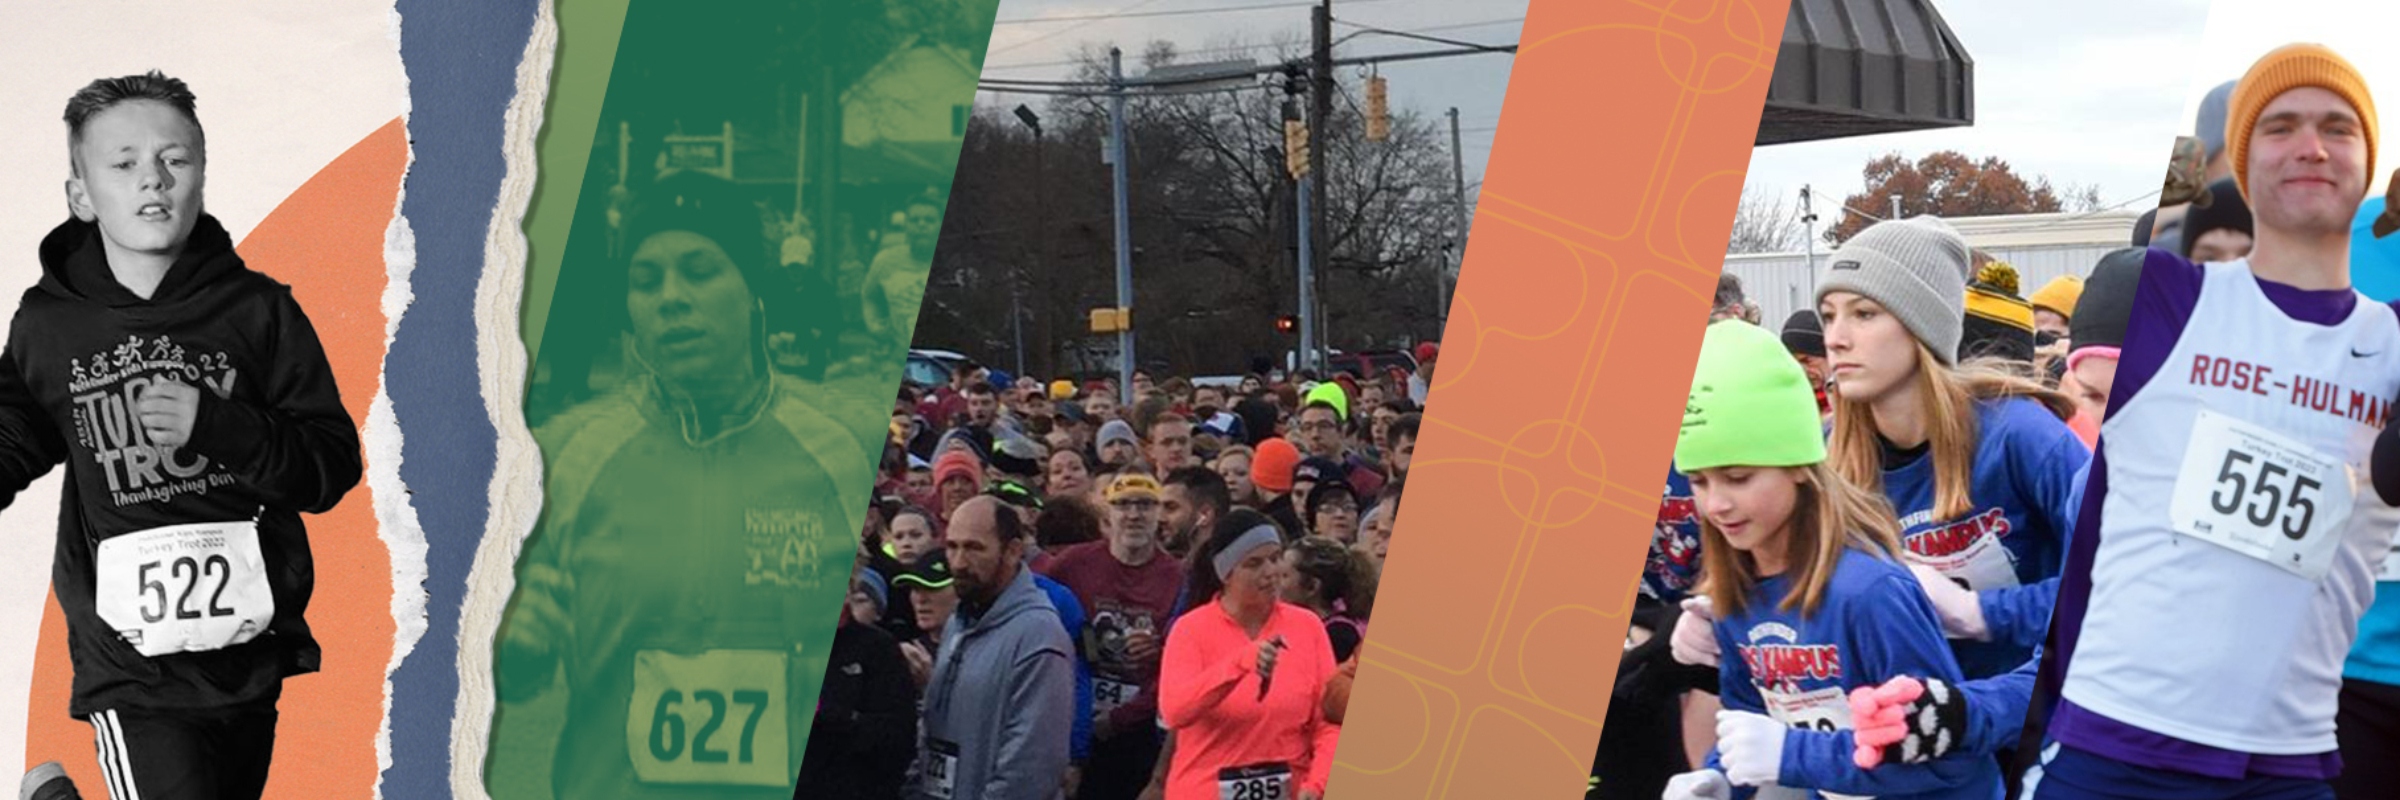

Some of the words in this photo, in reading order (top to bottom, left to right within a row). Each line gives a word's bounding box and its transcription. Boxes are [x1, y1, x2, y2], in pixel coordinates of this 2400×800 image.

[2210, 448, 2322, 542] 555
[138, 554, 235, 623] 522
[648, 687, 769, 764] 627
[1232, 776, 1281, 800] 285
